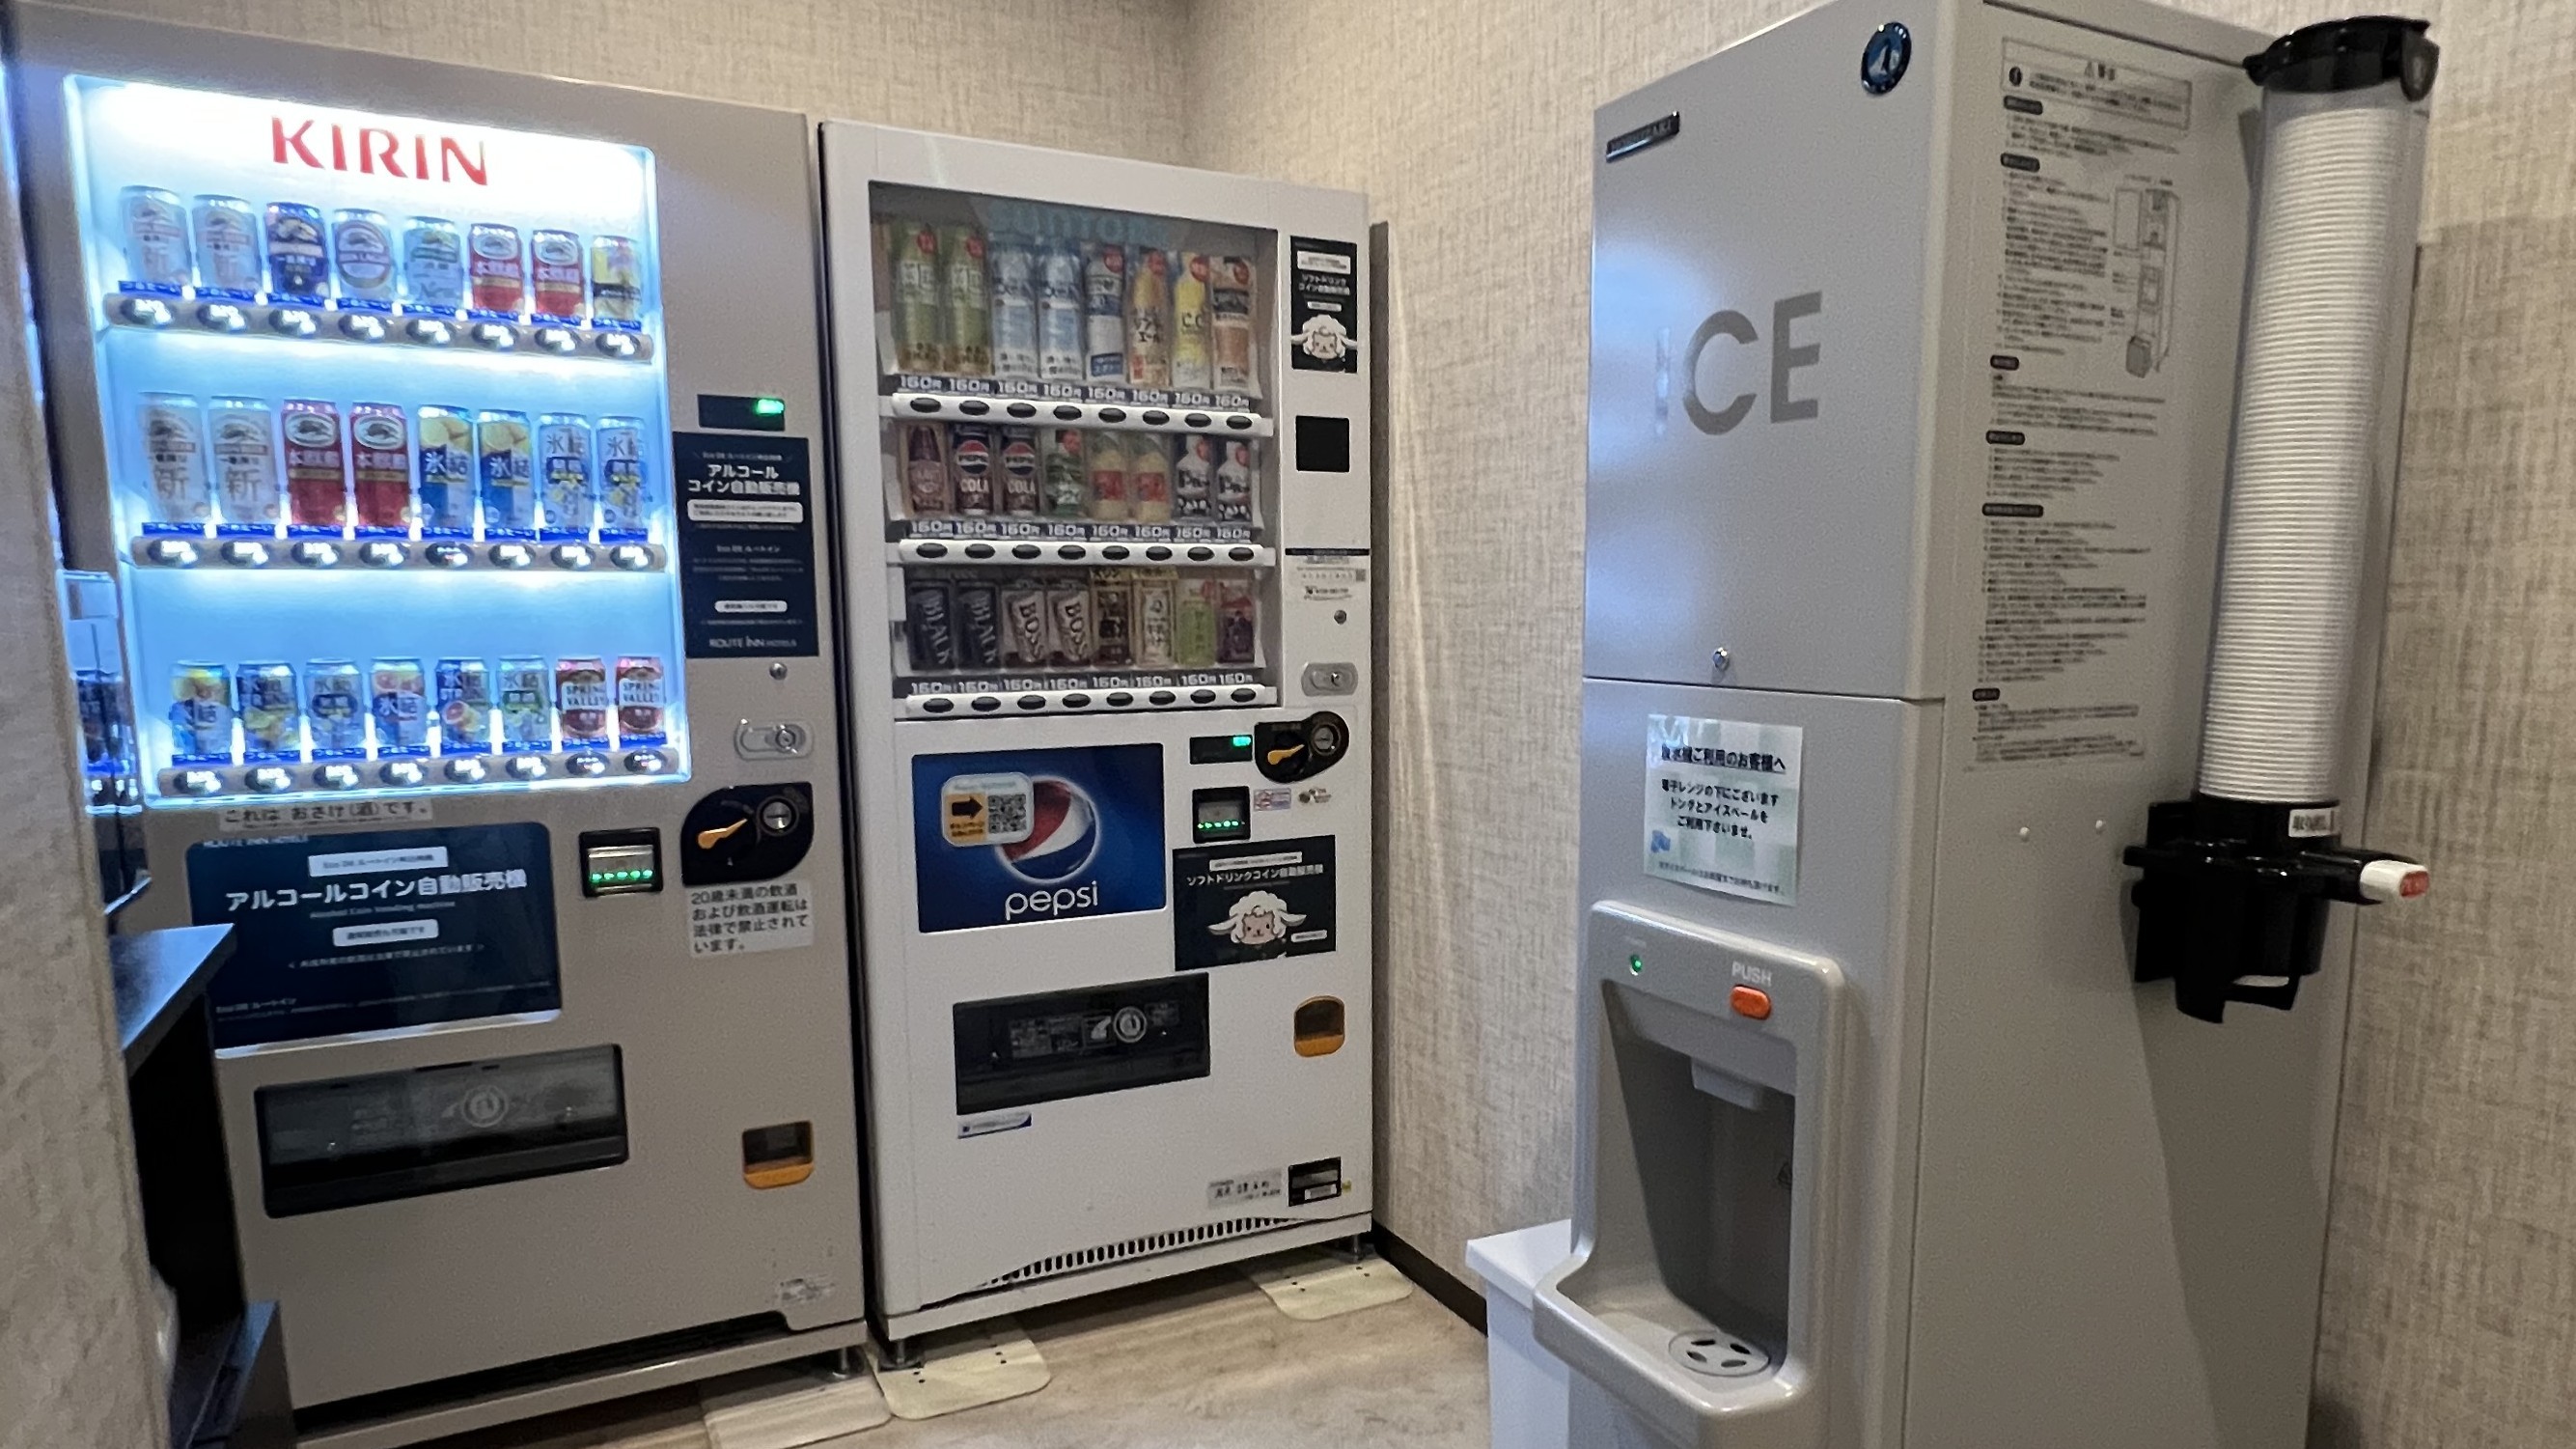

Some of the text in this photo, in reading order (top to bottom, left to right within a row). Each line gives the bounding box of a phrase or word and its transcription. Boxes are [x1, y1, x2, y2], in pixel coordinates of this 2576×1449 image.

[271, 115, 488, 185] KIRIN
[707, 464, 780, 480] アルコール
[960, 479, 989, 494] COLA
[1008, 481, 1037, 496] COLA
[224, 868, 528, 912] アルコールコイン自動販売機
[690, 882, 798, 906] 20歳未満の飲酒
[1005, 879, 1098, 921] pepsi
[692, 898, 809, 922] および飲酒運転は
[692, 914, 810, 938] 法律で禁止されて
[694, 936, 746, 954] います。
[1731, 960, 1773, 988] PUSH
